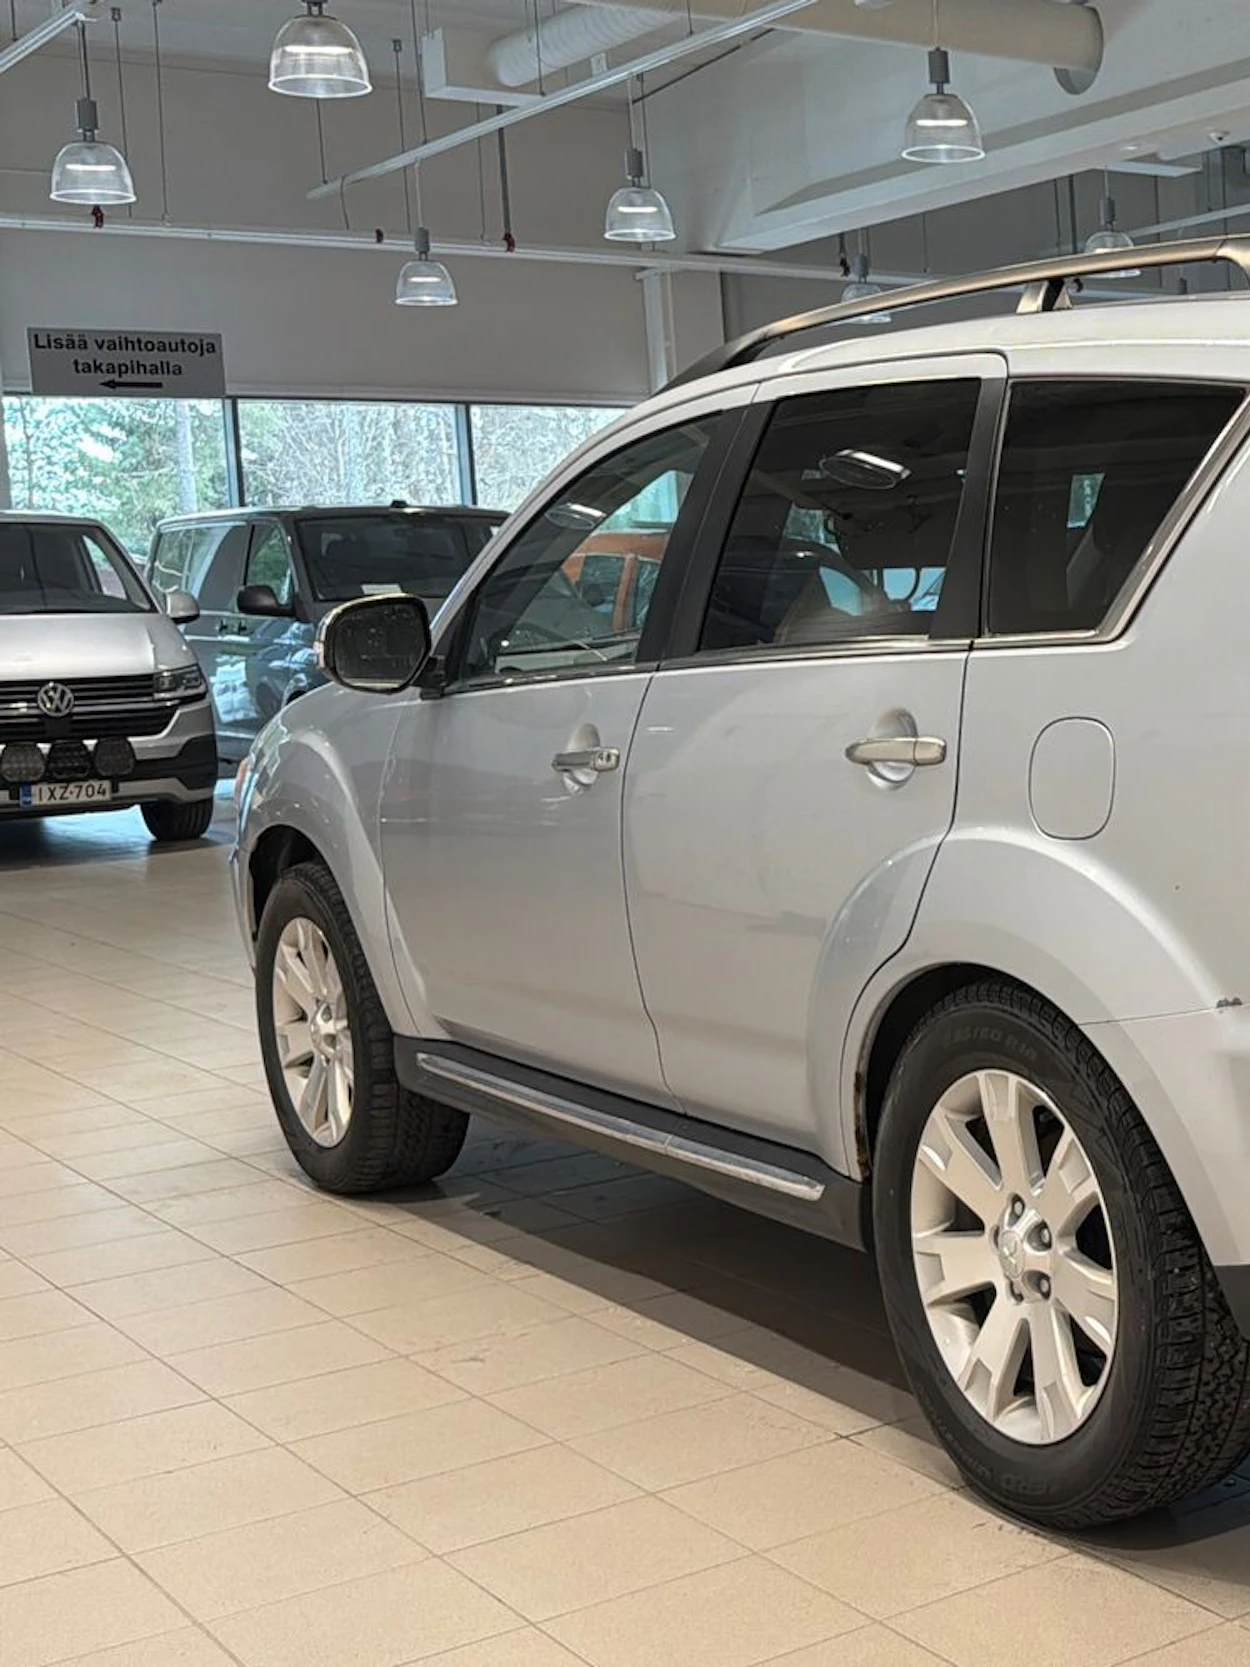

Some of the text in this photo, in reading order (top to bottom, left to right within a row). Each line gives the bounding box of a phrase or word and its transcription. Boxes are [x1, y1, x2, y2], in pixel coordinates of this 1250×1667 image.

[33, 333, 217, 357] Lisää vaihtoautoja
[72, 358, 184, 378] takapihalla
[38, 783, 107, 803] IXZ-704
